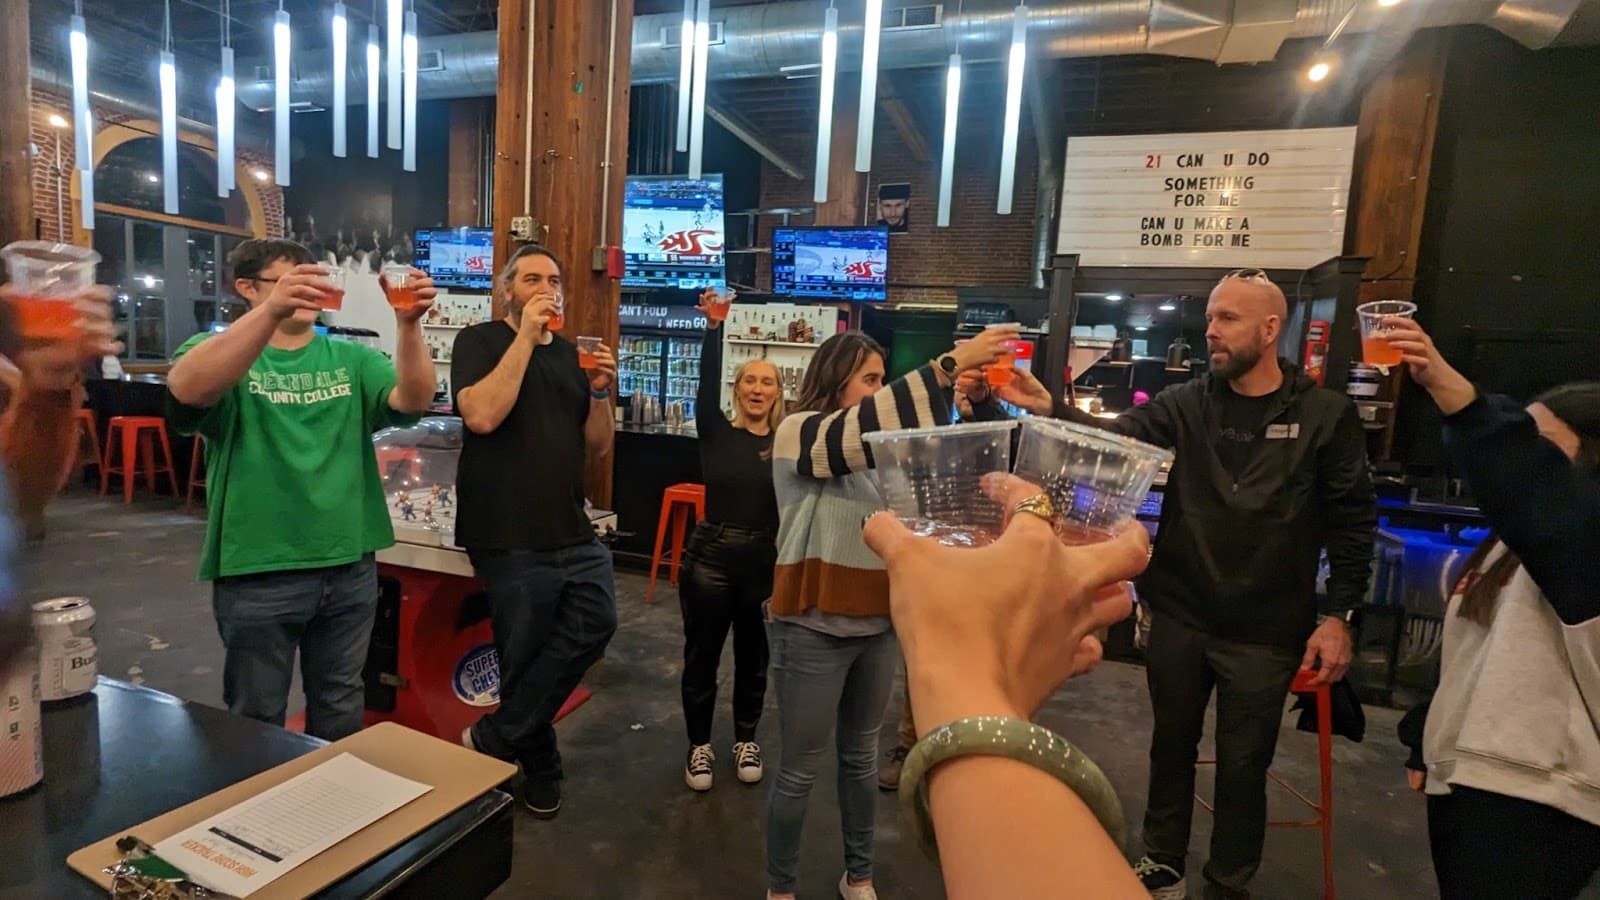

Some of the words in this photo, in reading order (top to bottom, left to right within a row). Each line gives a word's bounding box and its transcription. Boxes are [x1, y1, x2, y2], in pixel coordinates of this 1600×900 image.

[1146, 154, 1161, 168] 21
[1176, 154, 1204, 168] CAN
[1223, 153, 1233, 167] U
[1247, 152, 1270, 166] DO
[1164, 176, 1255, 191] SOMETHING
[1174, 194, 1205, 207] FOR
[1219, 193, 1240, 207] ME
[1140, 217, 1165, 231] CAN
[1174, 217, 1184, 230] U
[1194, 217, 1233, 230] MAKE
[1239, 217, 1250, 230] A
[1140, 233, 1183, 246] BOMB
[1193, 233, 1224, 246] FOR
[1231, 233, 1250, 247] ME
[303, 383, 352, 404] COLLEGE
